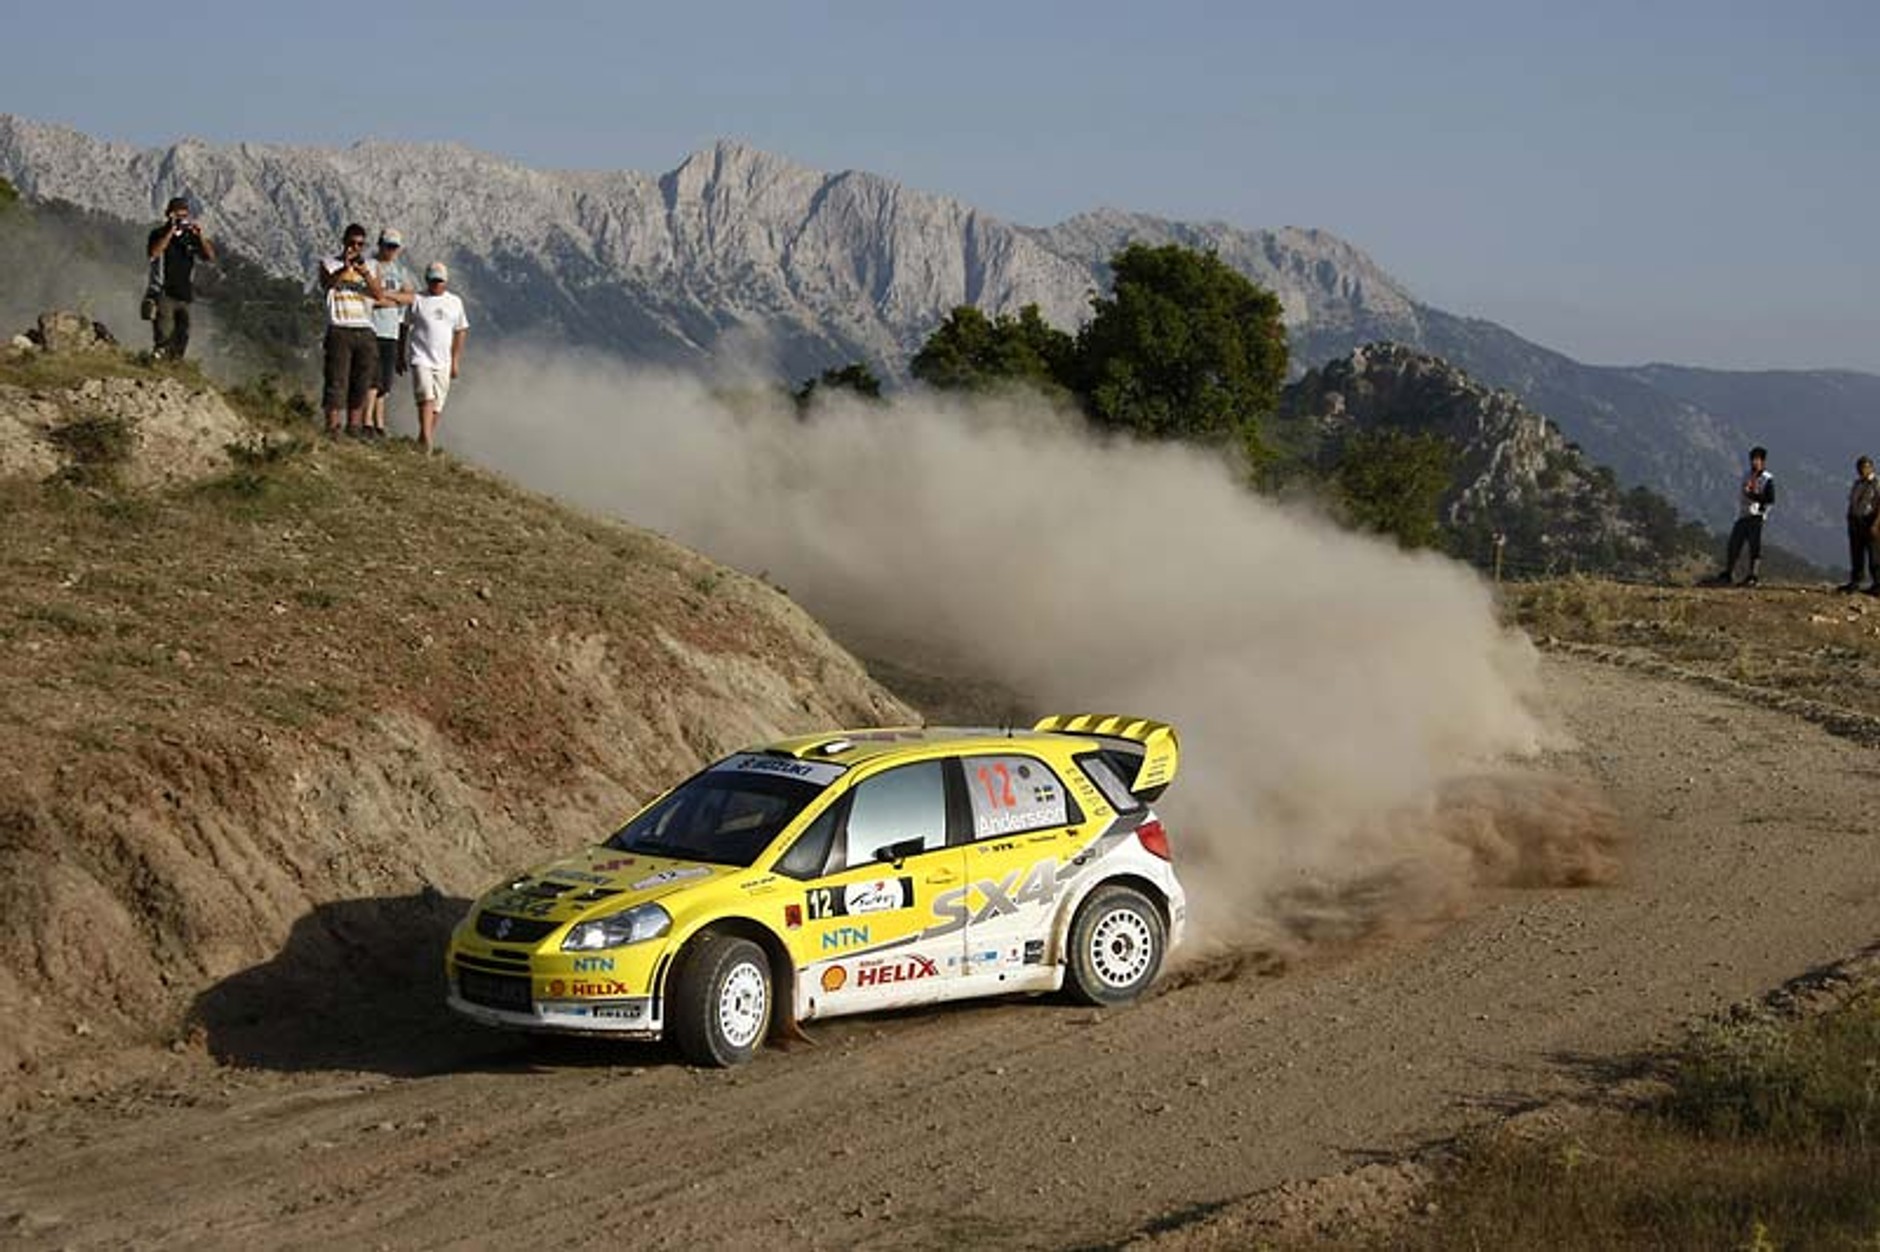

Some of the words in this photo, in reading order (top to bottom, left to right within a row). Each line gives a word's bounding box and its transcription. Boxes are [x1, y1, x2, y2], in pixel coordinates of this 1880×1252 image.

[977, 762, 1016, 810] 12
[978, 807, 1066, 838] Andersson
[810, 889, 834, 918] 12
[921, 857, 1062, 940] SX4
[822, 926, 869, 949] NTN
[574, 957, 615, 971] NTN
[857, 954, 939, 987] HELIX
[573, 980, 628, 995] HELIX
